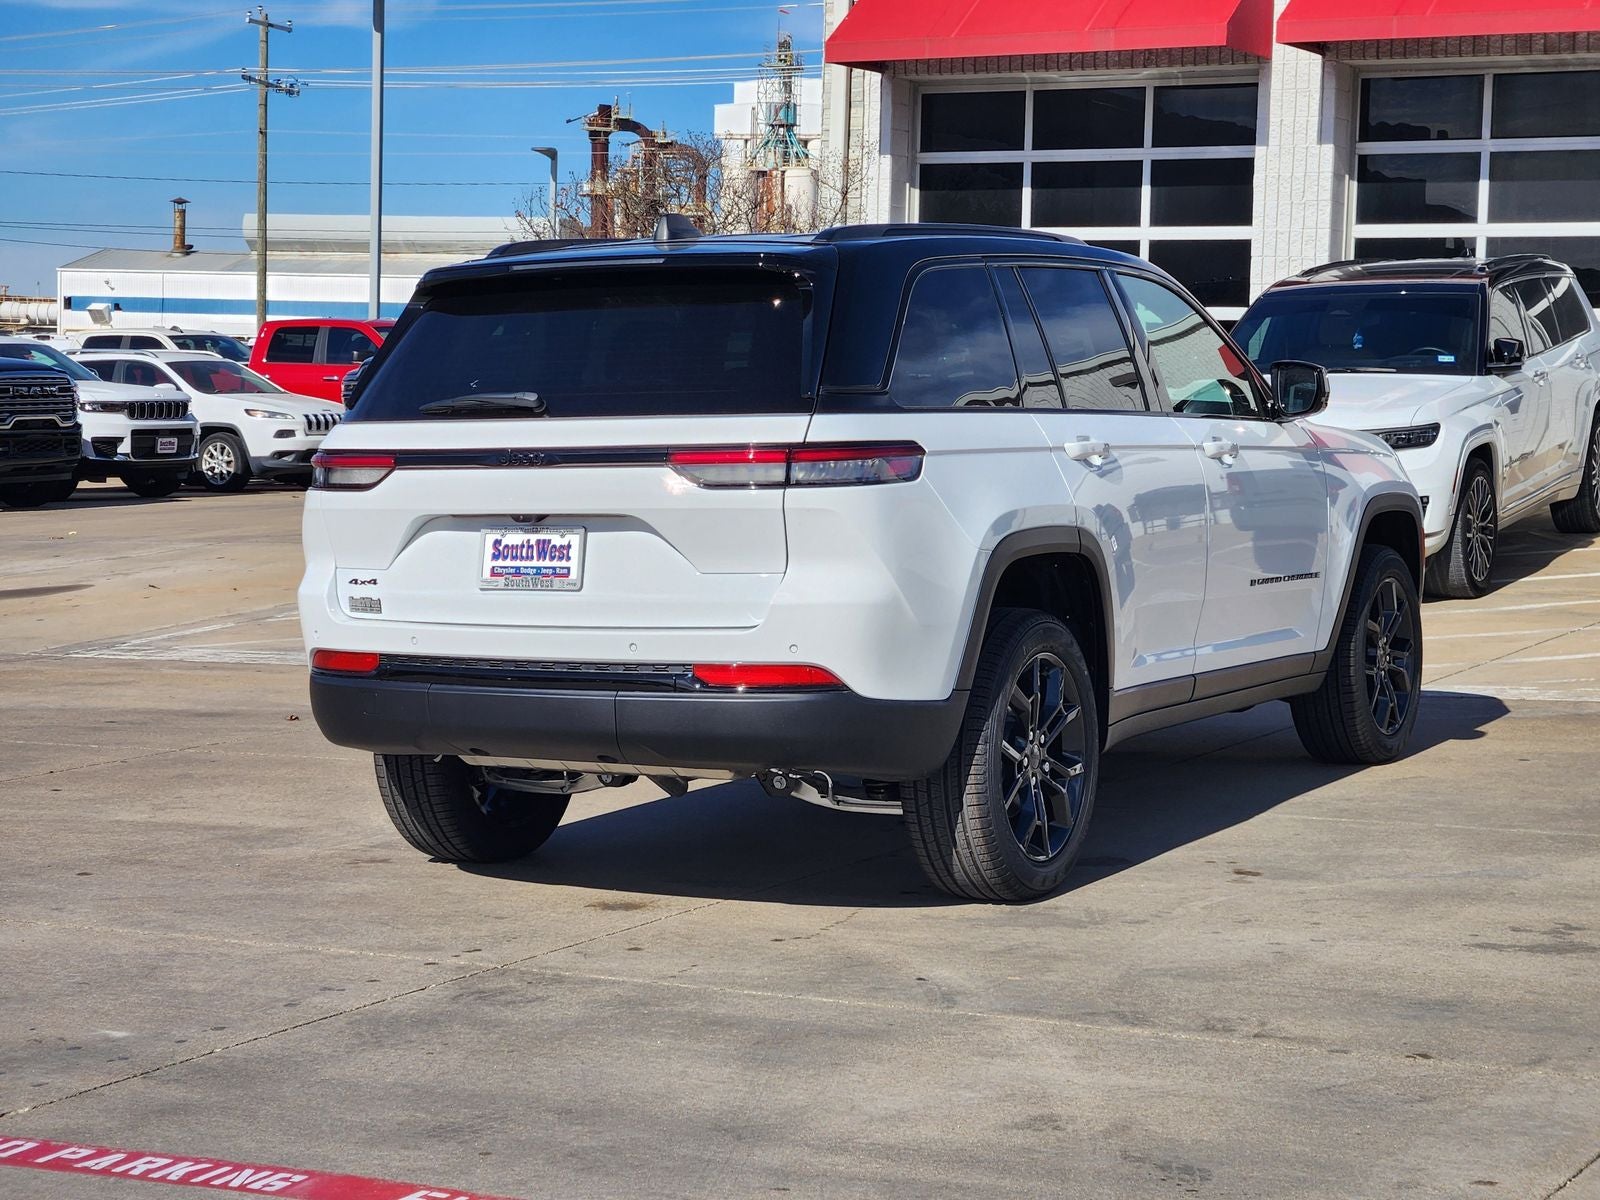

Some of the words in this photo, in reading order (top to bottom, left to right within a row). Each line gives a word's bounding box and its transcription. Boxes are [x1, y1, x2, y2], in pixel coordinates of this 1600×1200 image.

[13, 386, 58, 396] RAM
[499, 449, 545, 467] Jeep
[490, 538, 573, 562] SouthWest
[494, 566, 517, 575] Chrysler
[520, 567, 537, 575] Dodge
[541, 567, 553, 575] Jeep
[348, 578, 379, 586] 4x4
[503, 576, 555, 589] SouthWest
[33, 1146, 309, 1193] PARKING
